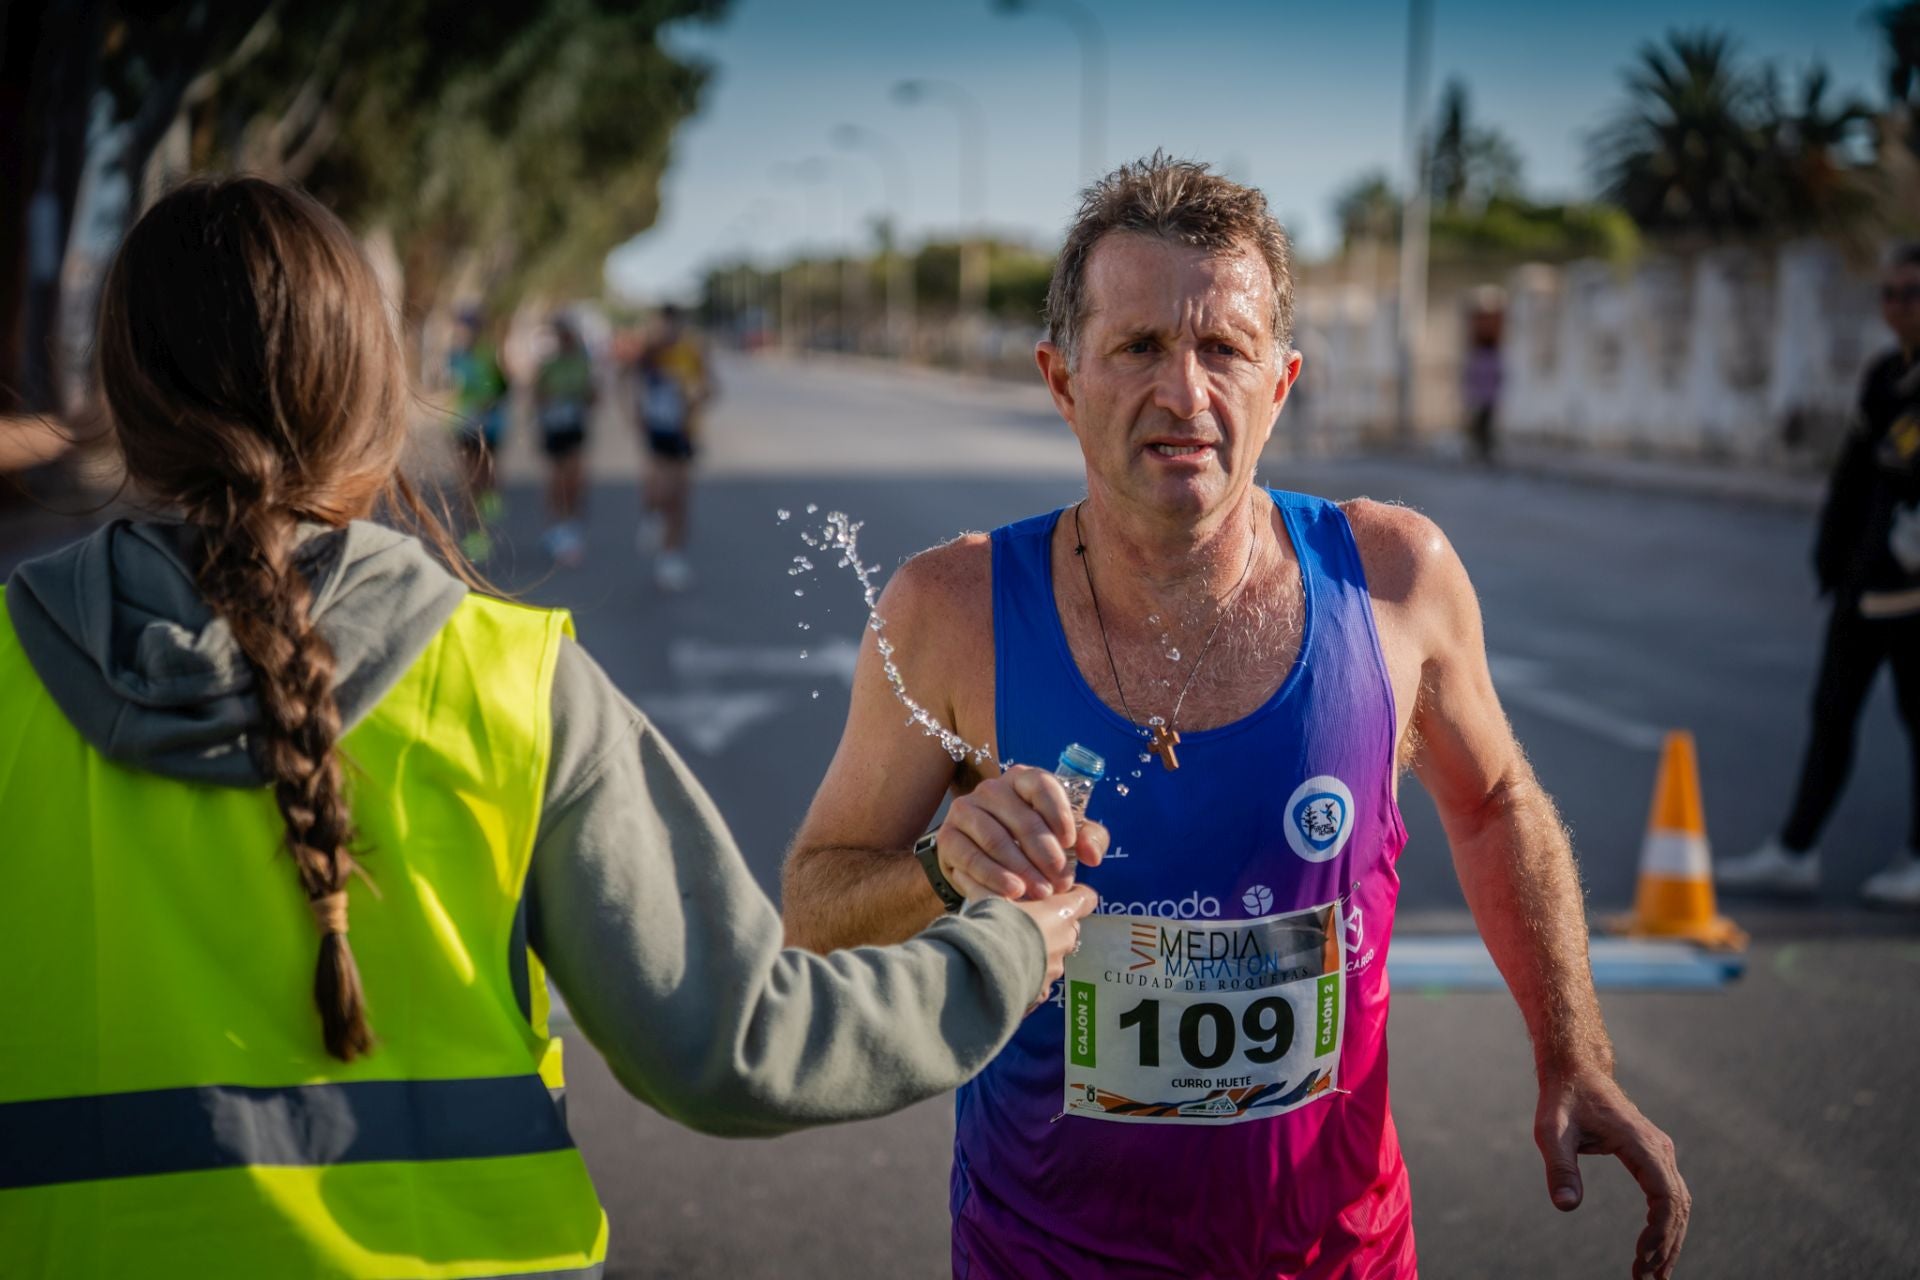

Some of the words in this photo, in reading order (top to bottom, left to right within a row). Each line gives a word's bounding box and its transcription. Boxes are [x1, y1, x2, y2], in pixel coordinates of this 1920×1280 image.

[1160, 926, 1262, 961] MEDIA
[1104, 970, 1174, 990] CIUDAD
[1185, 980, 1206, 991] DE
[1218, 968, 1309, 991] ROQUETAS
[1324, 984, 1334, 994] 2
[1078, 991, 1088, 1001] 2
[1076, 1004, 1088, 1056] CAJÓN
[1119, 996, 1295, 1069] 109
[1322, 996, 1333, 1045] CAJÓN
[1171, 1078, 1212, 1089] CURRO
[1216, 1076, 1252, 1089] HUETE
